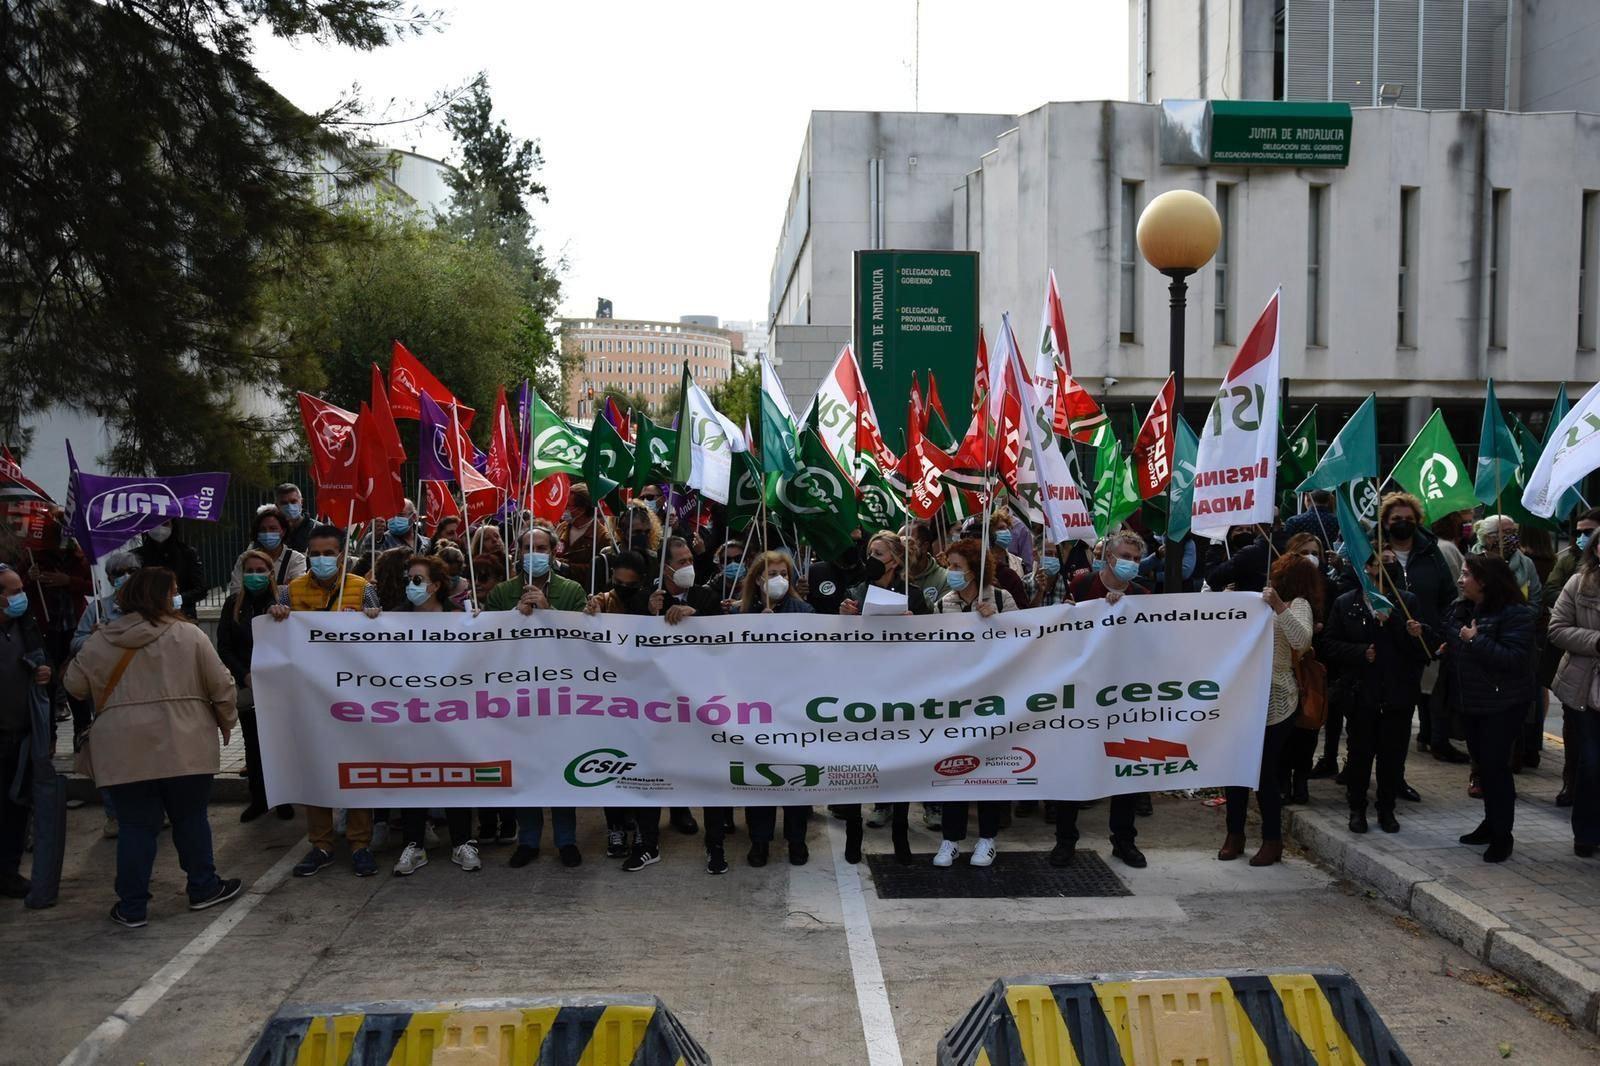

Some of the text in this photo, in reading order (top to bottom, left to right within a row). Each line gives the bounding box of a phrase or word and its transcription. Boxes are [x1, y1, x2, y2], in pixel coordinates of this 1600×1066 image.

[1248, 128, 1277, 139] JUNTA
[1282, 128, 1292, 139] DE
[901, 268, 951, 277] DELEGACIÓN DEL
[873, 324, 883, 336] DE
[873, 340, 883, 370] JUNTA
[1145, 446, 1159, 488] Huelva
[101, 493, 171, 523] UGT
[309, 607, 1247, 647] Personal laboral temporal y personal funcionario interino de la Junta de Andalucía
[336, 665, 617, 688] Procesos reales de
[329, 679, 1220, 724] estabilización Contra el cese
[711, 707, 1221, 748] de empleadas y empleados públicos
[579, 759, 637, 774] CSIF
[828, 764, 879, 773] INICIATIVA
[940, 757, 974, 768] UGT
[1115, 760, 1198, 777] USTEA
[349, 767, 471, 784] CCOO
[829, 778, 879, 786] ANDALUZA
